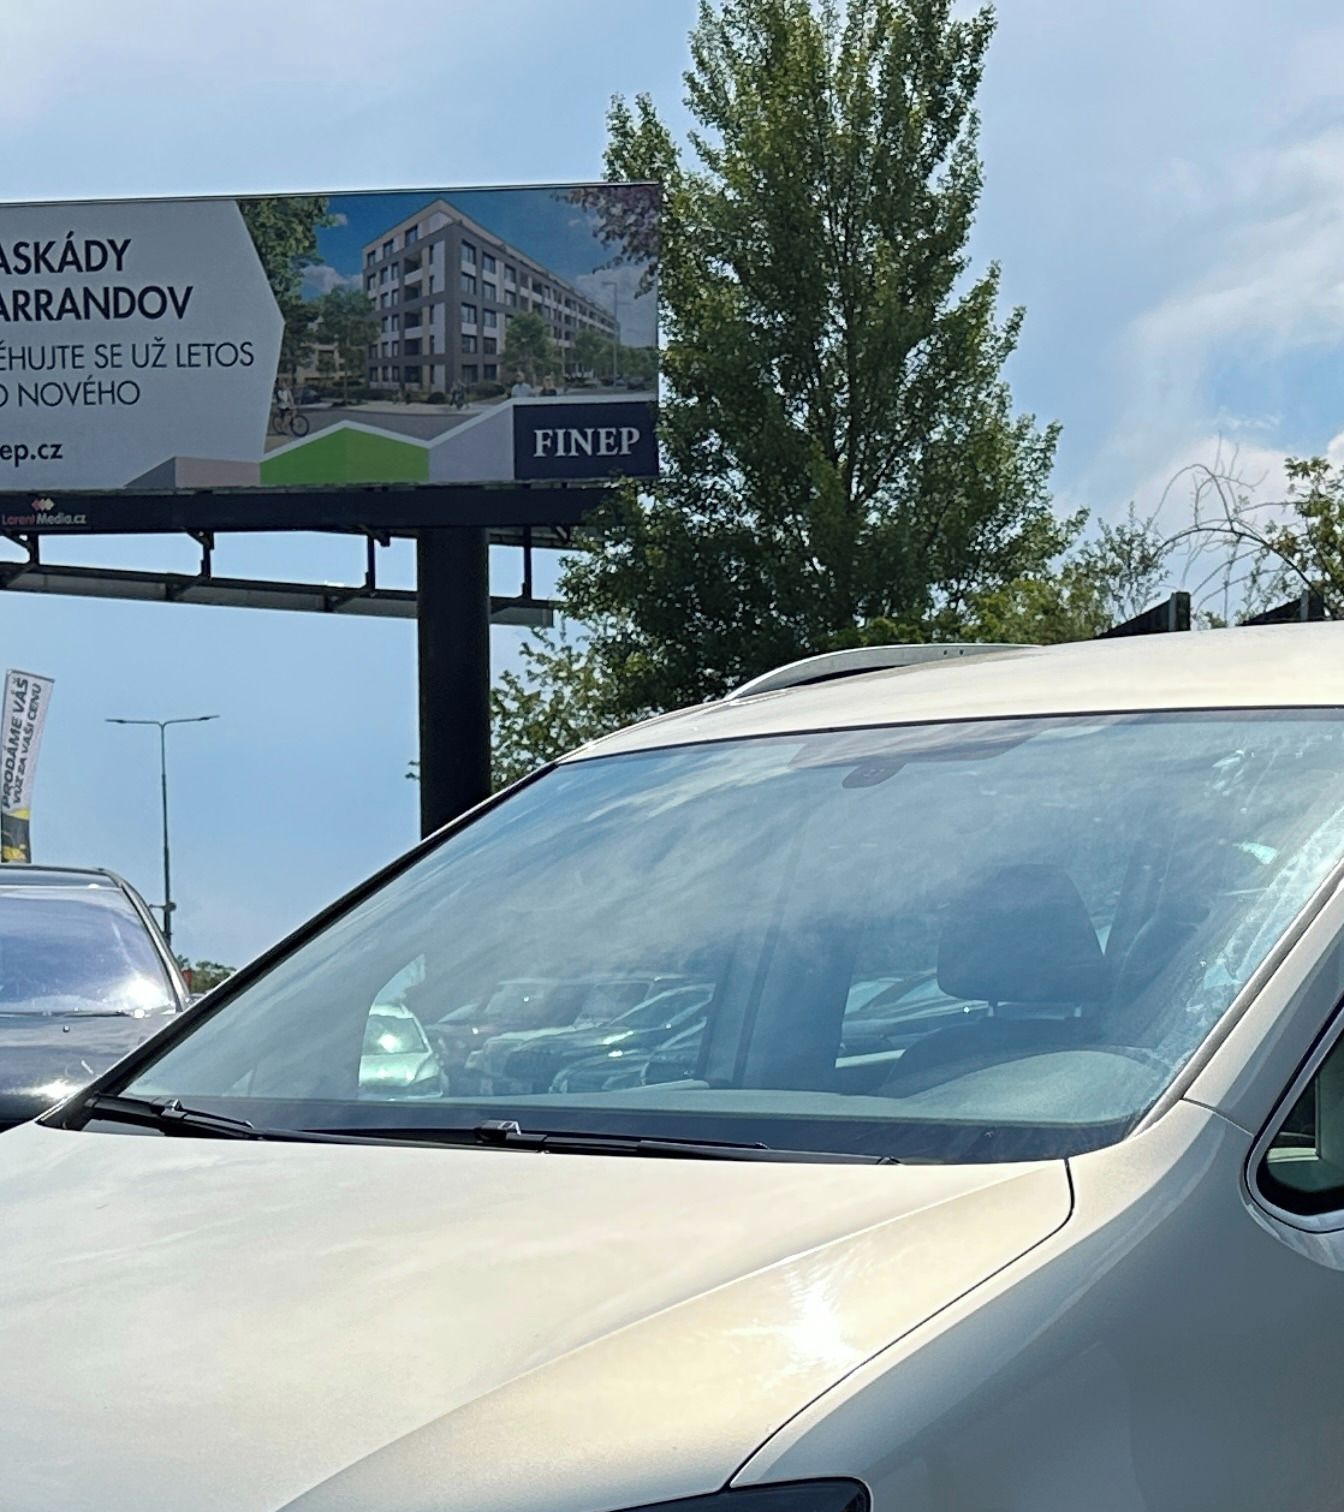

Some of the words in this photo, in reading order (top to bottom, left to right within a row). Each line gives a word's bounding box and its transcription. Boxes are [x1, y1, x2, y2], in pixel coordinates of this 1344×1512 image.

[94, 344, 123, 369] SE
[132, 336, 167, 368] UŽ
[176, 342, 255, 368] LETOS
[18, 374, 140, 407] NOVÉHO
[533, 427, 640, 457] FINEP
[27, 683, 42, 721] CENU
[1, 715, 23, 808] PRODÁME
[12, 678, 29, 713] VÁŠ
